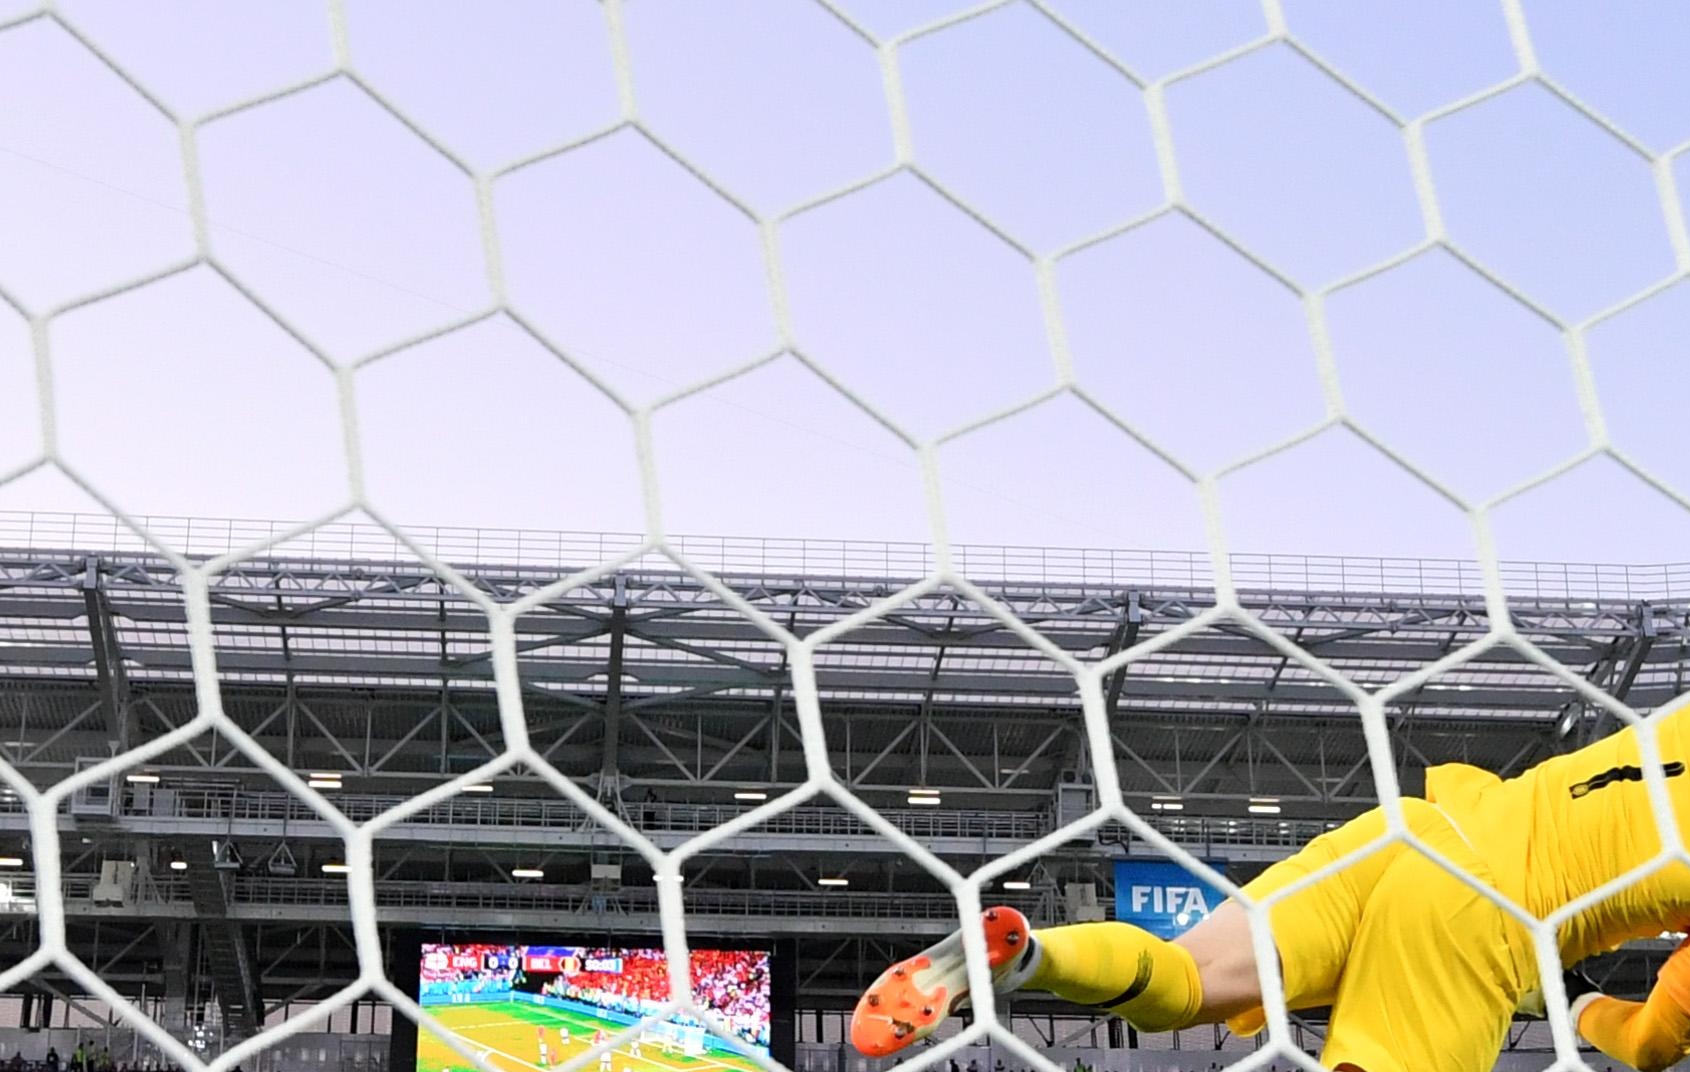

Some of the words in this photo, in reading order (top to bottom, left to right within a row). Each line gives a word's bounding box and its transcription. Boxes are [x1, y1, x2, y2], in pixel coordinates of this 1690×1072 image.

[1570, 761, 1685, 799] 1
[1131, 885, 1207, 914] FIFA
[452, 957, 477, 968] ENG
